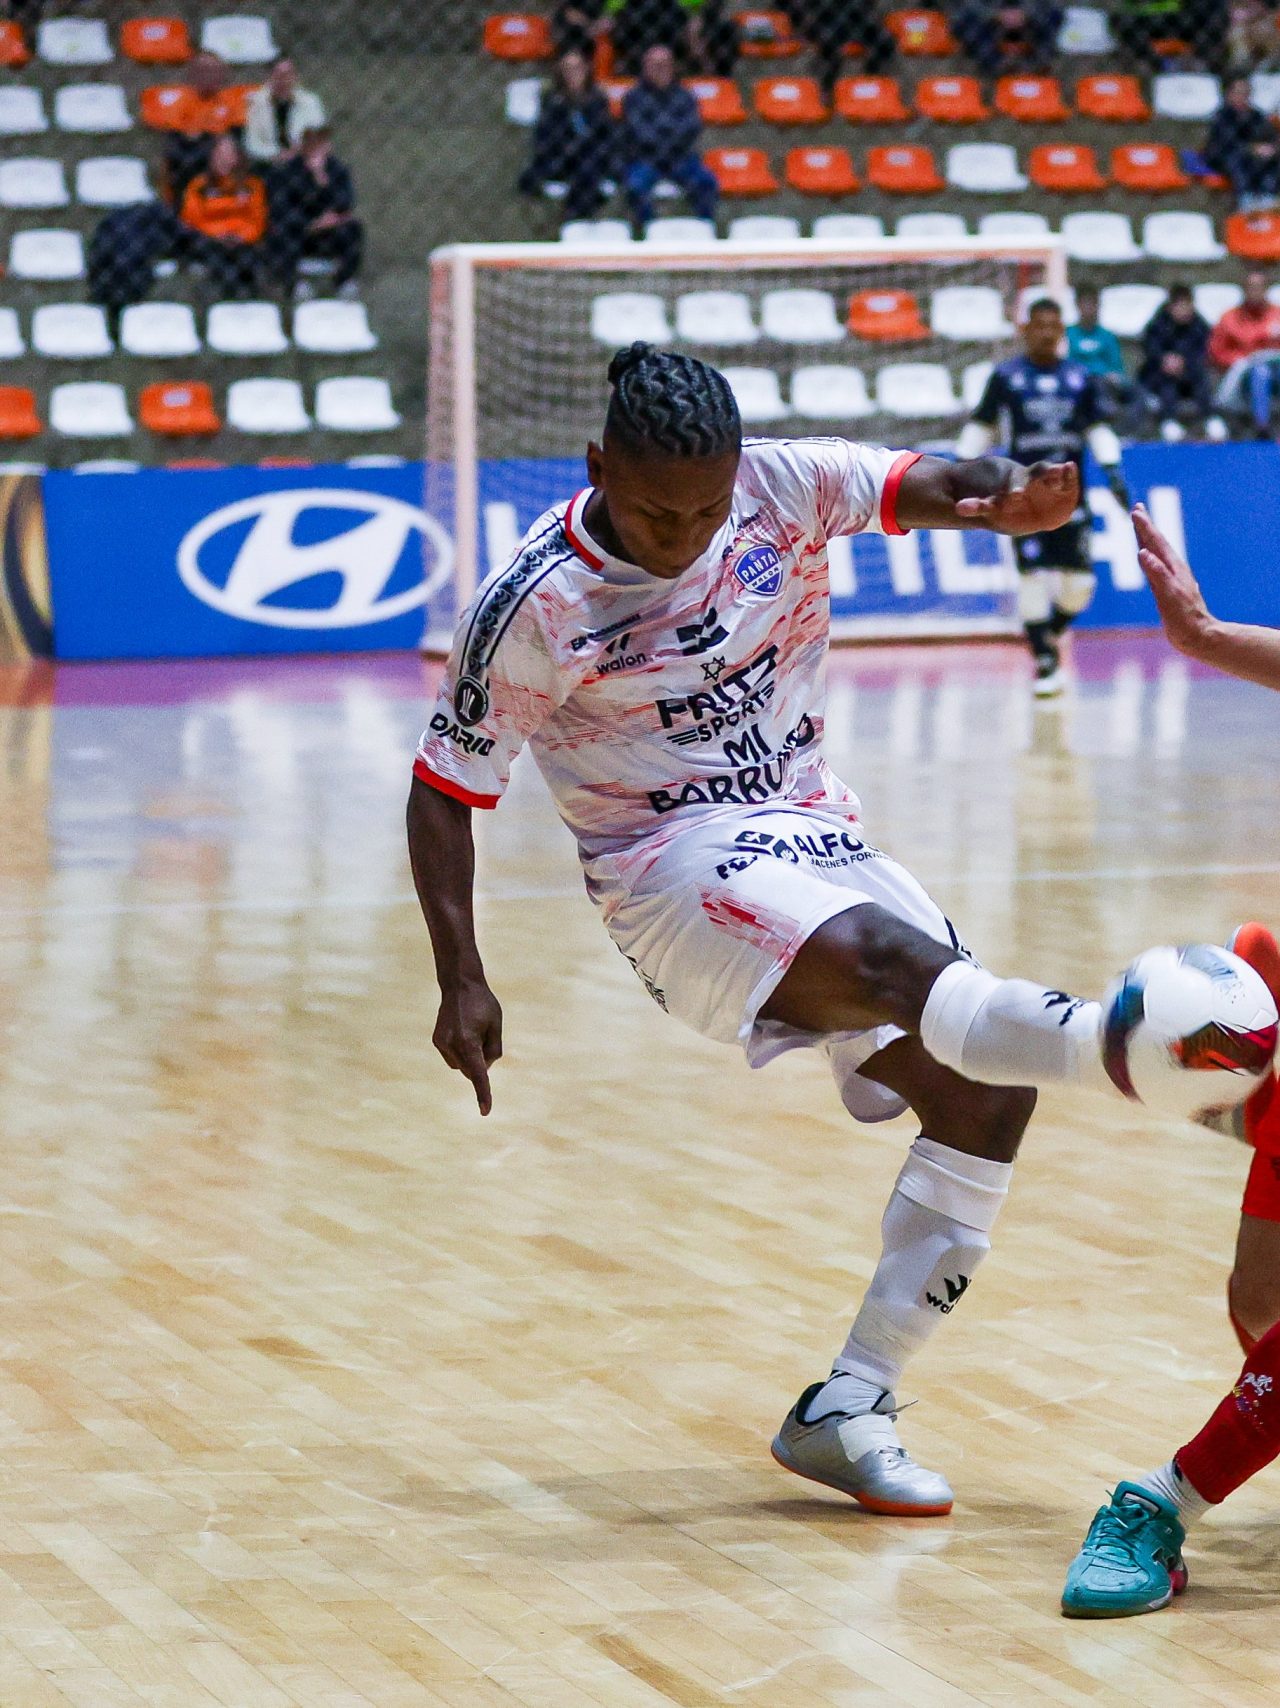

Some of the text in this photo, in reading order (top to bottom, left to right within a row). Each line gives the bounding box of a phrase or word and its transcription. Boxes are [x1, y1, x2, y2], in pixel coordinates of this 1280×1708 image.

[741, 552, 777, 582] PANTA
[596, 652, 647, 674] walon
[722, 723, 772, 768] MI
[794, 832, 880, 858] ALFO
